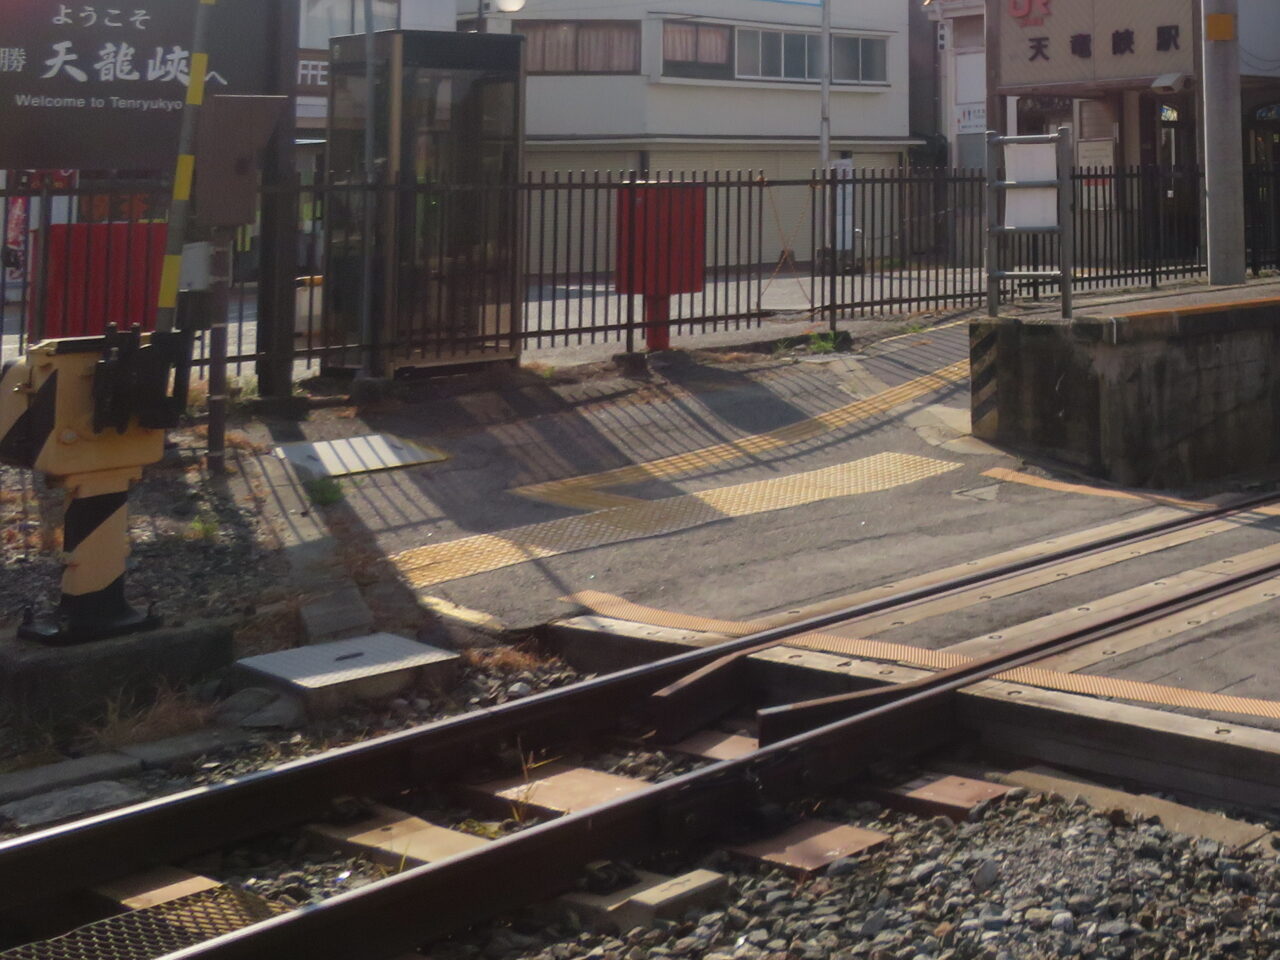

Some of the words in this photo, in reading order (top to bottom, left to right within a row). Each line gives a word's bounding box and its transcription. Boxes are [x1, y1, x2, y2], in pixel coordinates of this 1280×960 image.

[52, 4, 151, 30] ようこそ
[15, 94, 86, 108] Welcome
[91, 96, 105, 108] to
[110, 96, 184, 112] Tenryukyo
